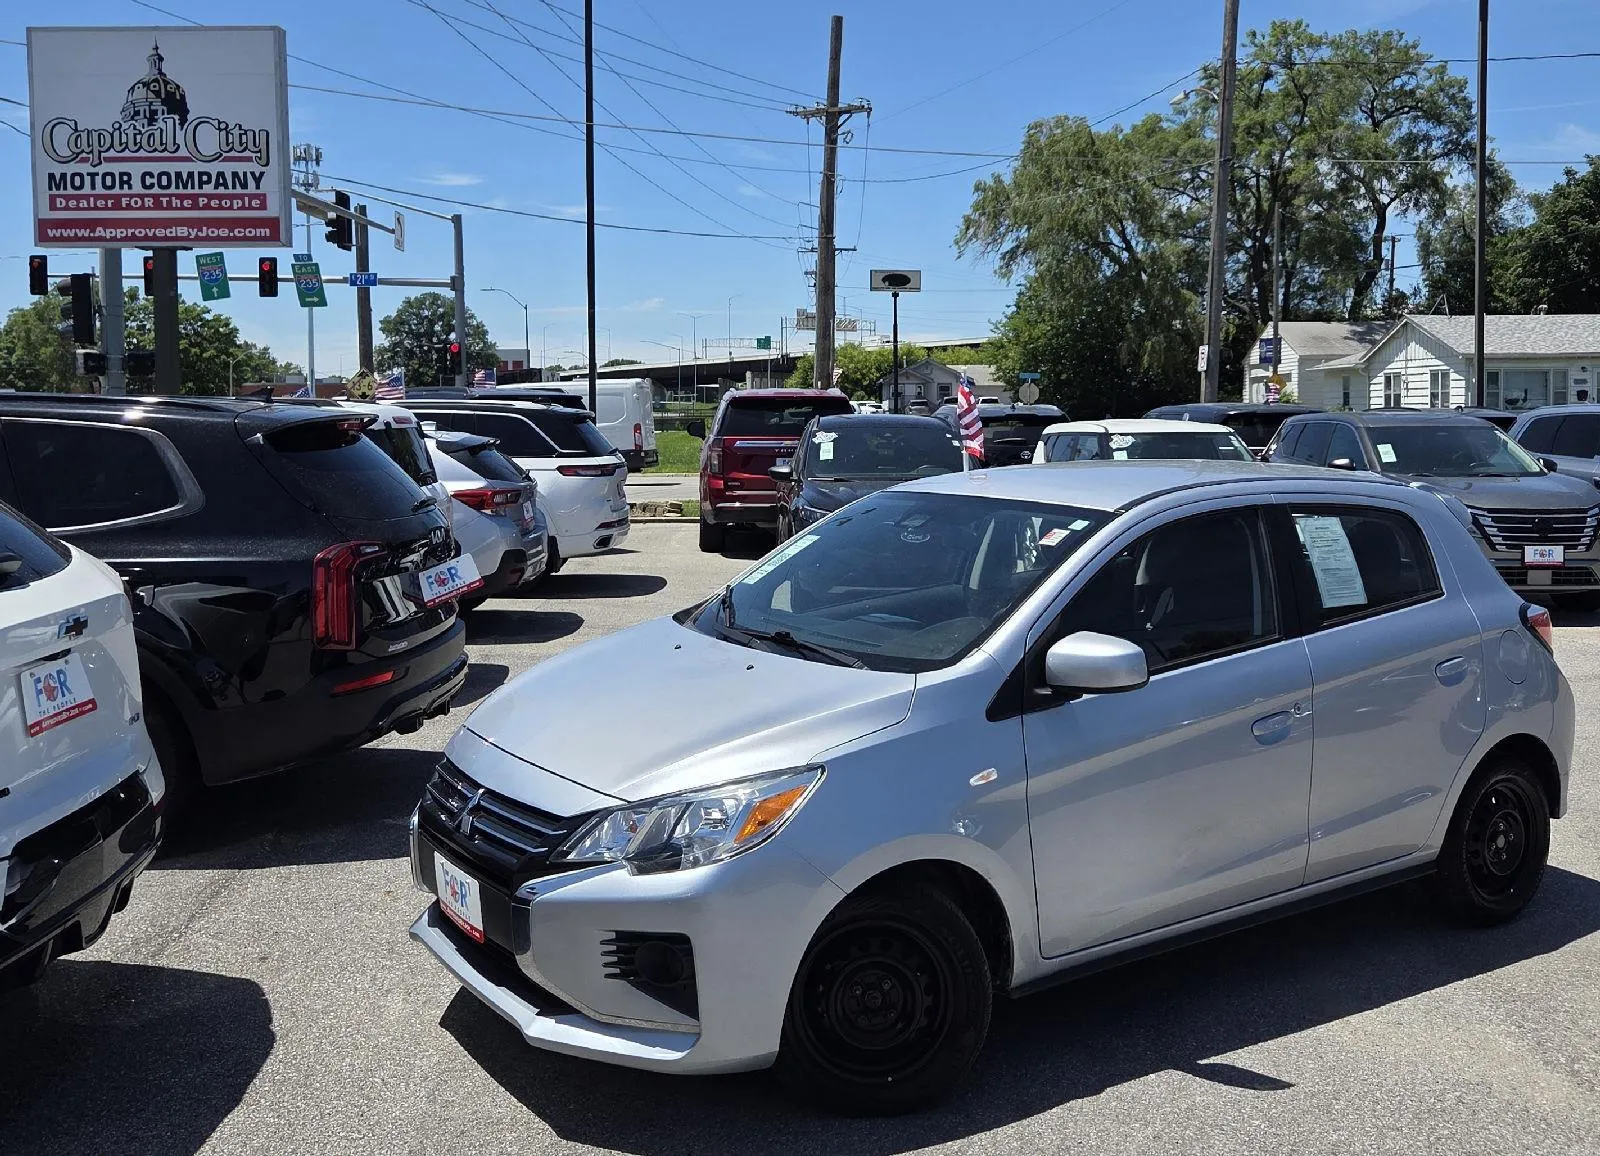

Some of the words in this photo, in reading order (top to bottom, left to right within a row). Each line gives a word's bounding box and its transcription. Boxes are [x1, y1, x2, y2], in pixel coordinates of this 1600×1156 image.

[42, 116, 180, 168] Capital
[184, 116, 270, 167] City
[48, 171, 133, 191] MOTOR
[140, 171, 266, 191] COMPANY
[56, 197, 115, 208] Dealer
[121, 197, 154, 208] FOR
[159, 196, 192, 208] The
[198, 196, 261, 210] People
[46, 226, 271, 239] www.ApprovedByJoe.com
[200, 255, 221, 265] WEST
[203, 269, 223, 280] 235
[295, 264, 316, 273] EAST
[300, 279, 319, 288] 235
[33, 668, 74, 707] FOR
